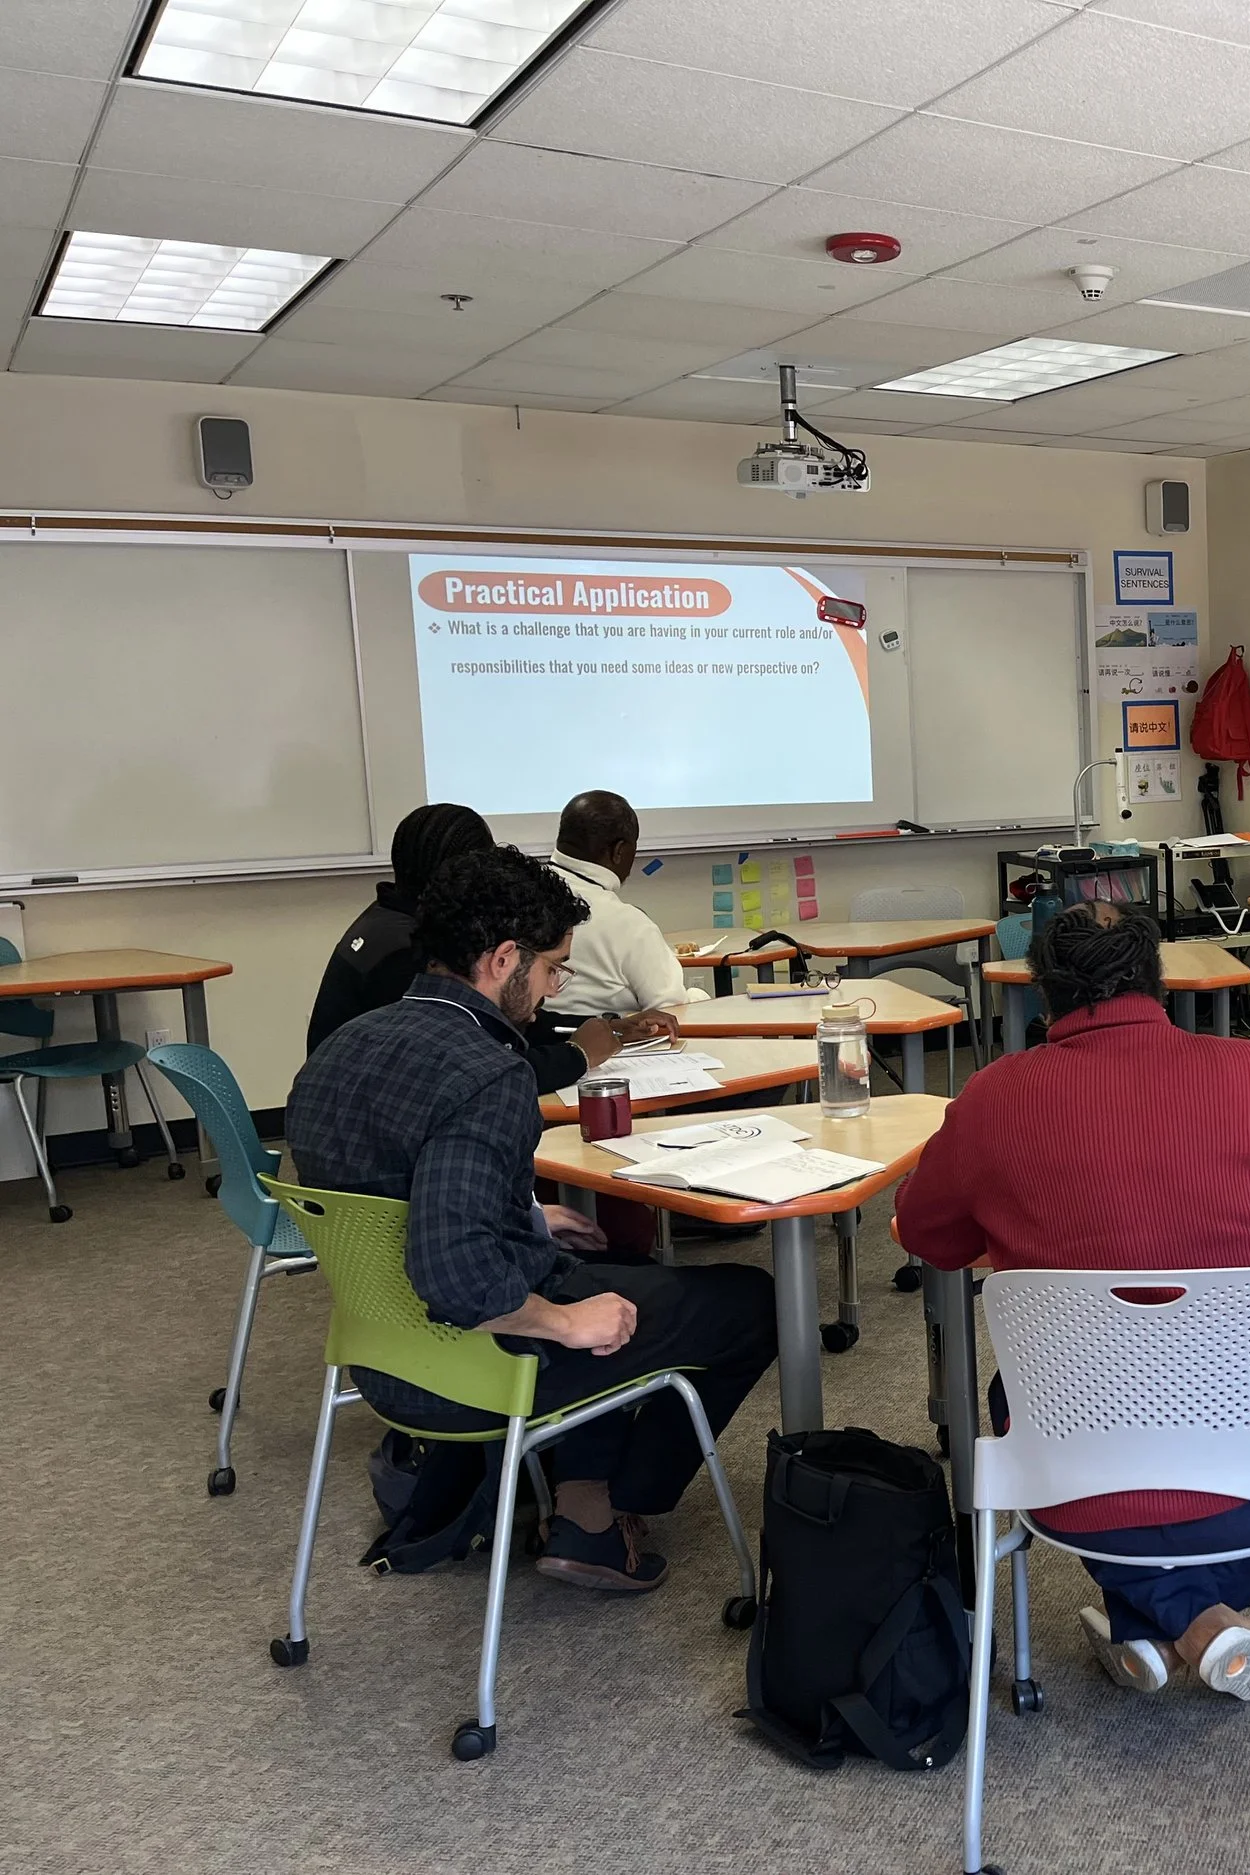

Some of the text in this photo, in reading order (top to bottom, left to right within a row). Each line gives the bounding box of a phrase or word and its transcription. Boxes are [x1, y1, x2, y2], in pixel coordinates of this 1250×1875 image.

[1125, 568, 1164, 576] SURVIVAL
[1121, 580, 1169, 588] SENTENCES
[445, 577, 709, 612] Practical Application
[448, 620, 833, 640] What is a challenge that you are having in your current role and/or
[451, 660, 820, 676] responsibilities that you need some ideas or new perspective on?
